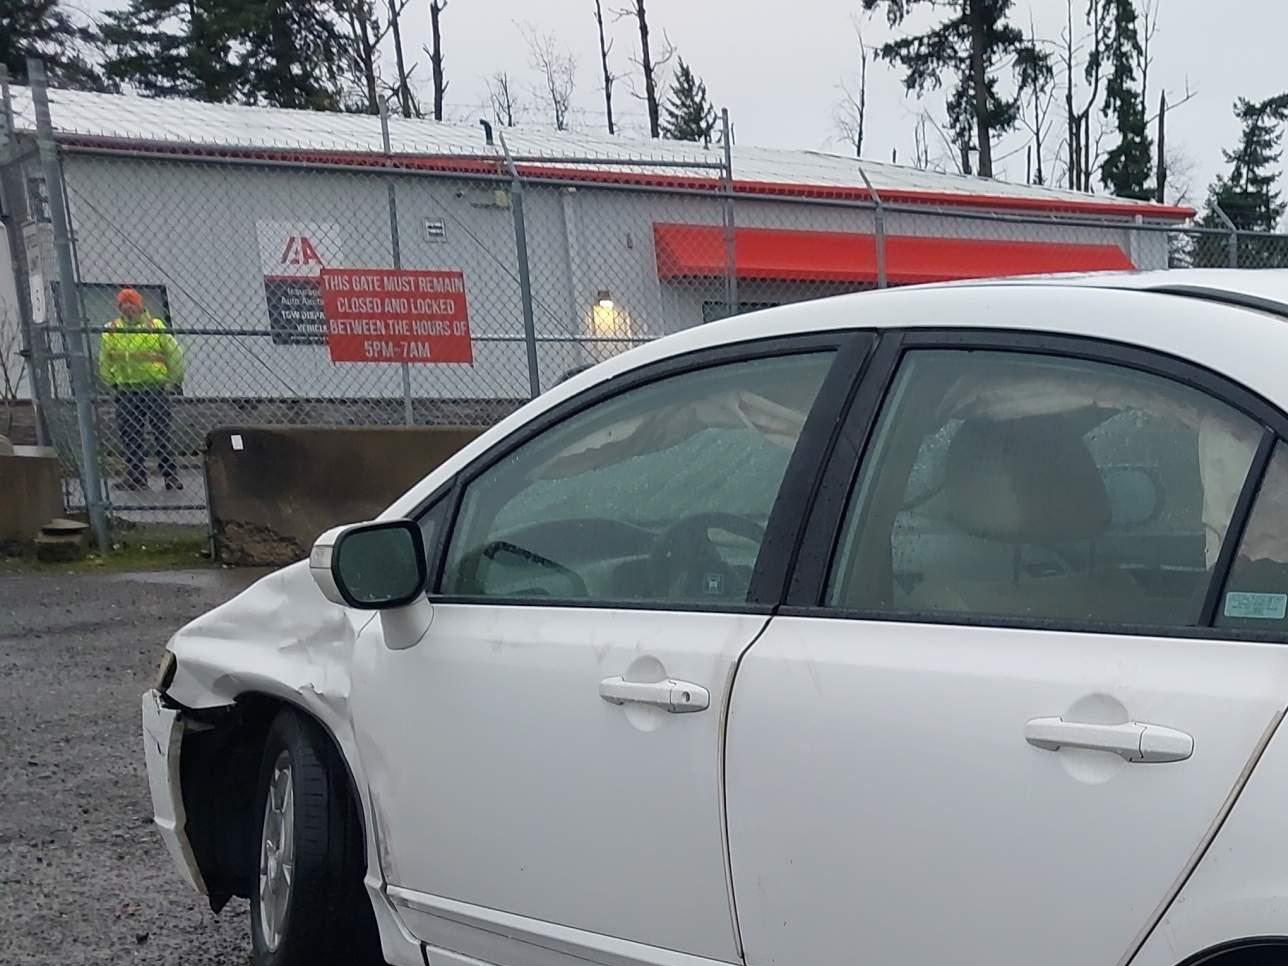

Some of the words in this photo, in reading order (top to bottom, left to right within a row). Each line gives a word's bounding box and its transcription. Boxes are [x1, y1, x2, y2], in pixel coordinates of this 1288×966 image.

[323, 275, 349, 291] THIS
[352, 275, 381, 291] GATE
[384, 276, 416, 292] MUST
[418, 276, 463, 293] REMAIN
[337, 297, 381, 313] CLOSED
[384, 298, 408, 314] AND
[411, 298, 455, 314] LOCKED
[329, 319, 385, 335] BETWEEN
[386, 320, 411, 335] THE
[413, 320, 451, 336] HOURS
[453, 321, 467, 336] OF
[364, 340, 431, 358] 5PM-7AM
